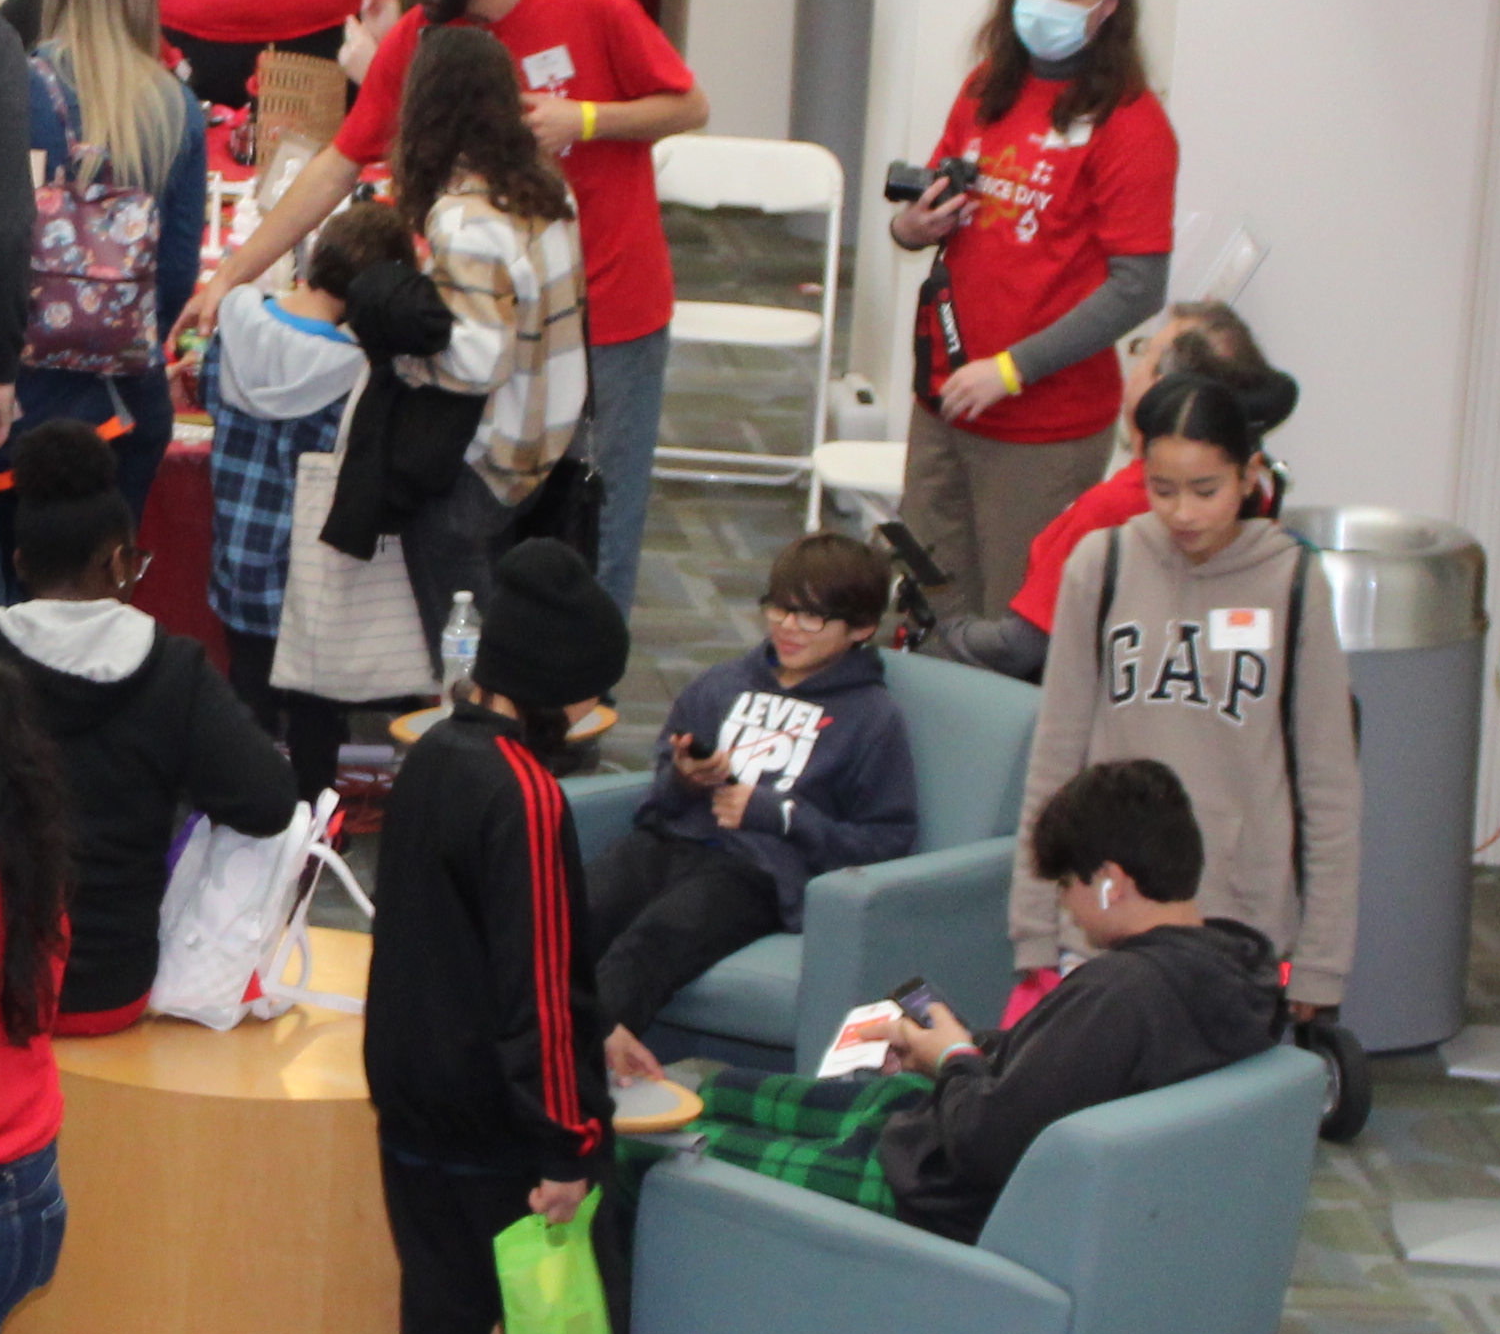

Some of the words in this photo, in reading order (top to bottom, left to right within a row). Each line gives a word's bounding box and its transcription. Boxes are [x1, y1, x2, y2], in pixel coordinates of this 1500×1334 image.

[1015, 183, 1055, 211] DAY
[1108, 620, 1268, 726] GAP
[727, 690, 825, 737] LEVEL
